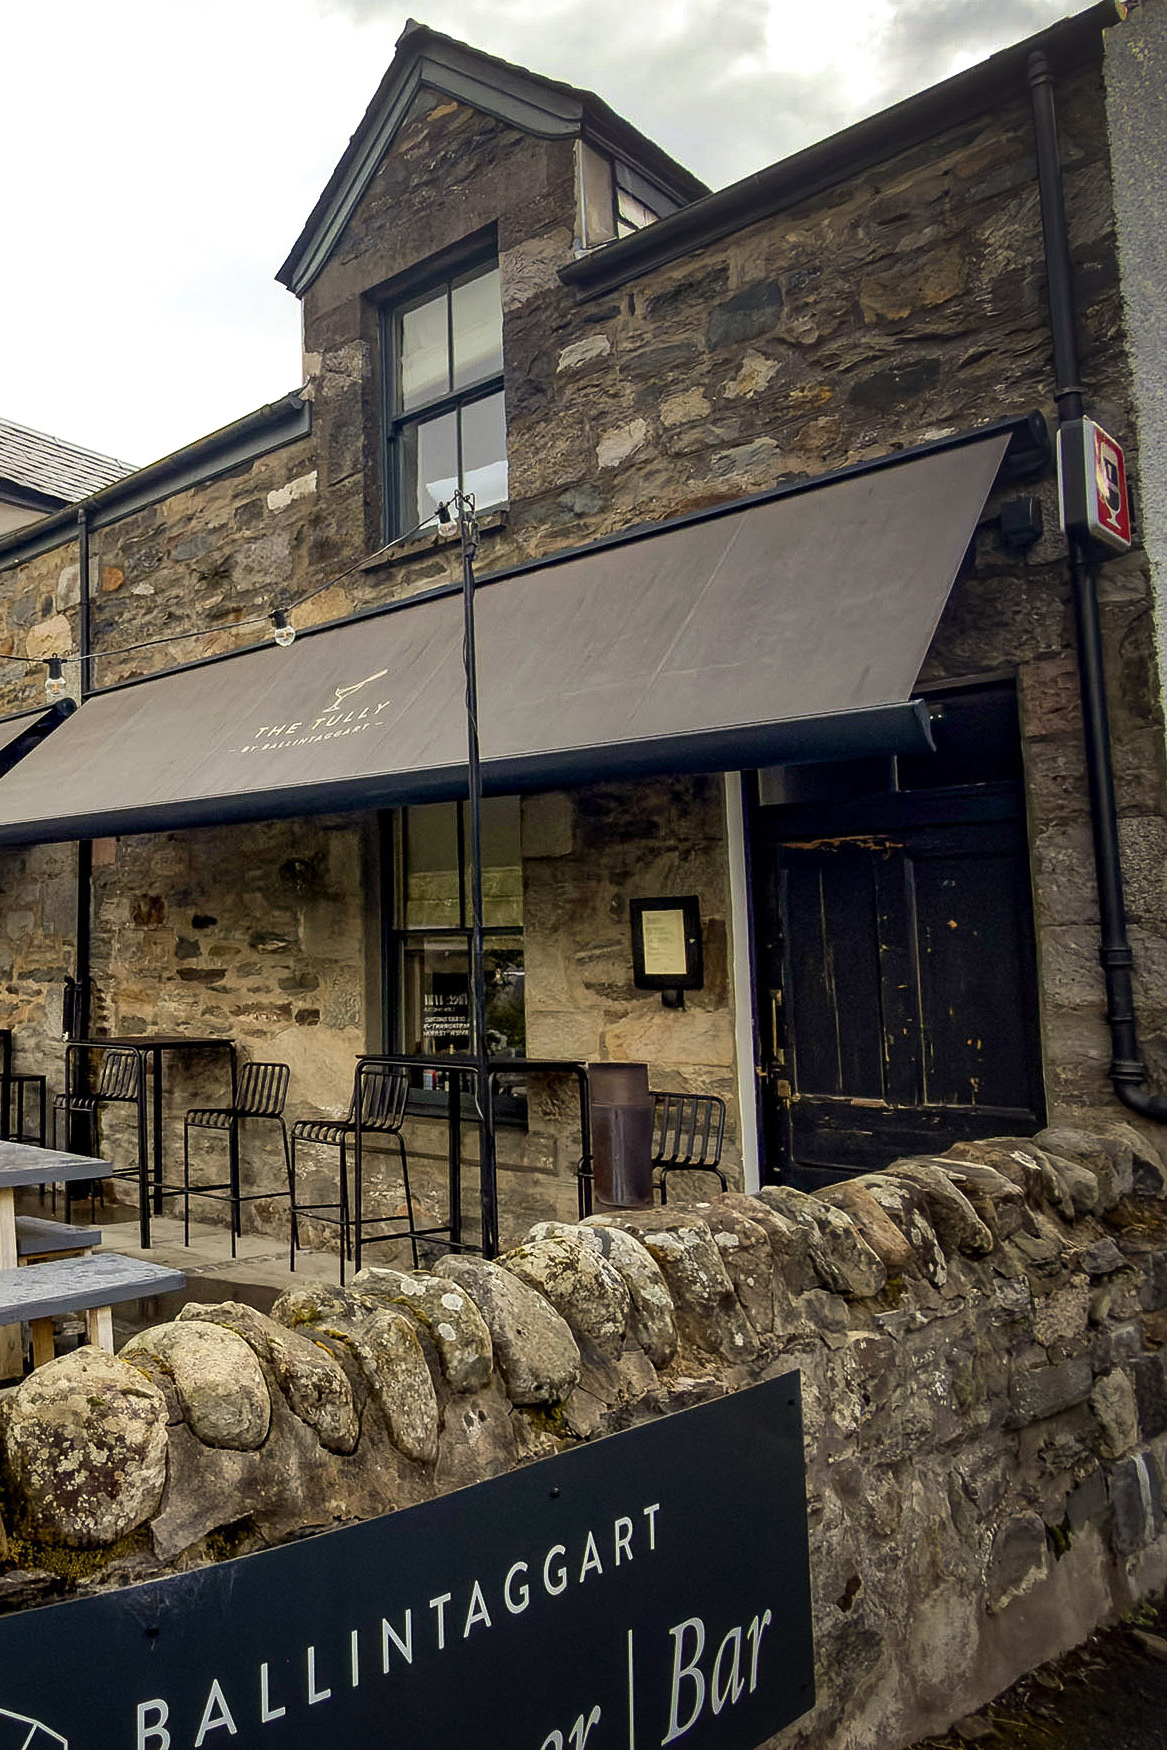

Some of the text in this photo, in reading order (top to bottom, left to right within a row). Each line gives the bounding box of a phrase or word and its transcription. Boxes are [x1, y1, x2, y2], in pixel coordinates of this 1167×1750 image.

[254, 700, 391, 739] THE TULLY
[136, 1503, 661, 1750] BALLINTAGGART
[660, 1608, 772, 1747] Bar
